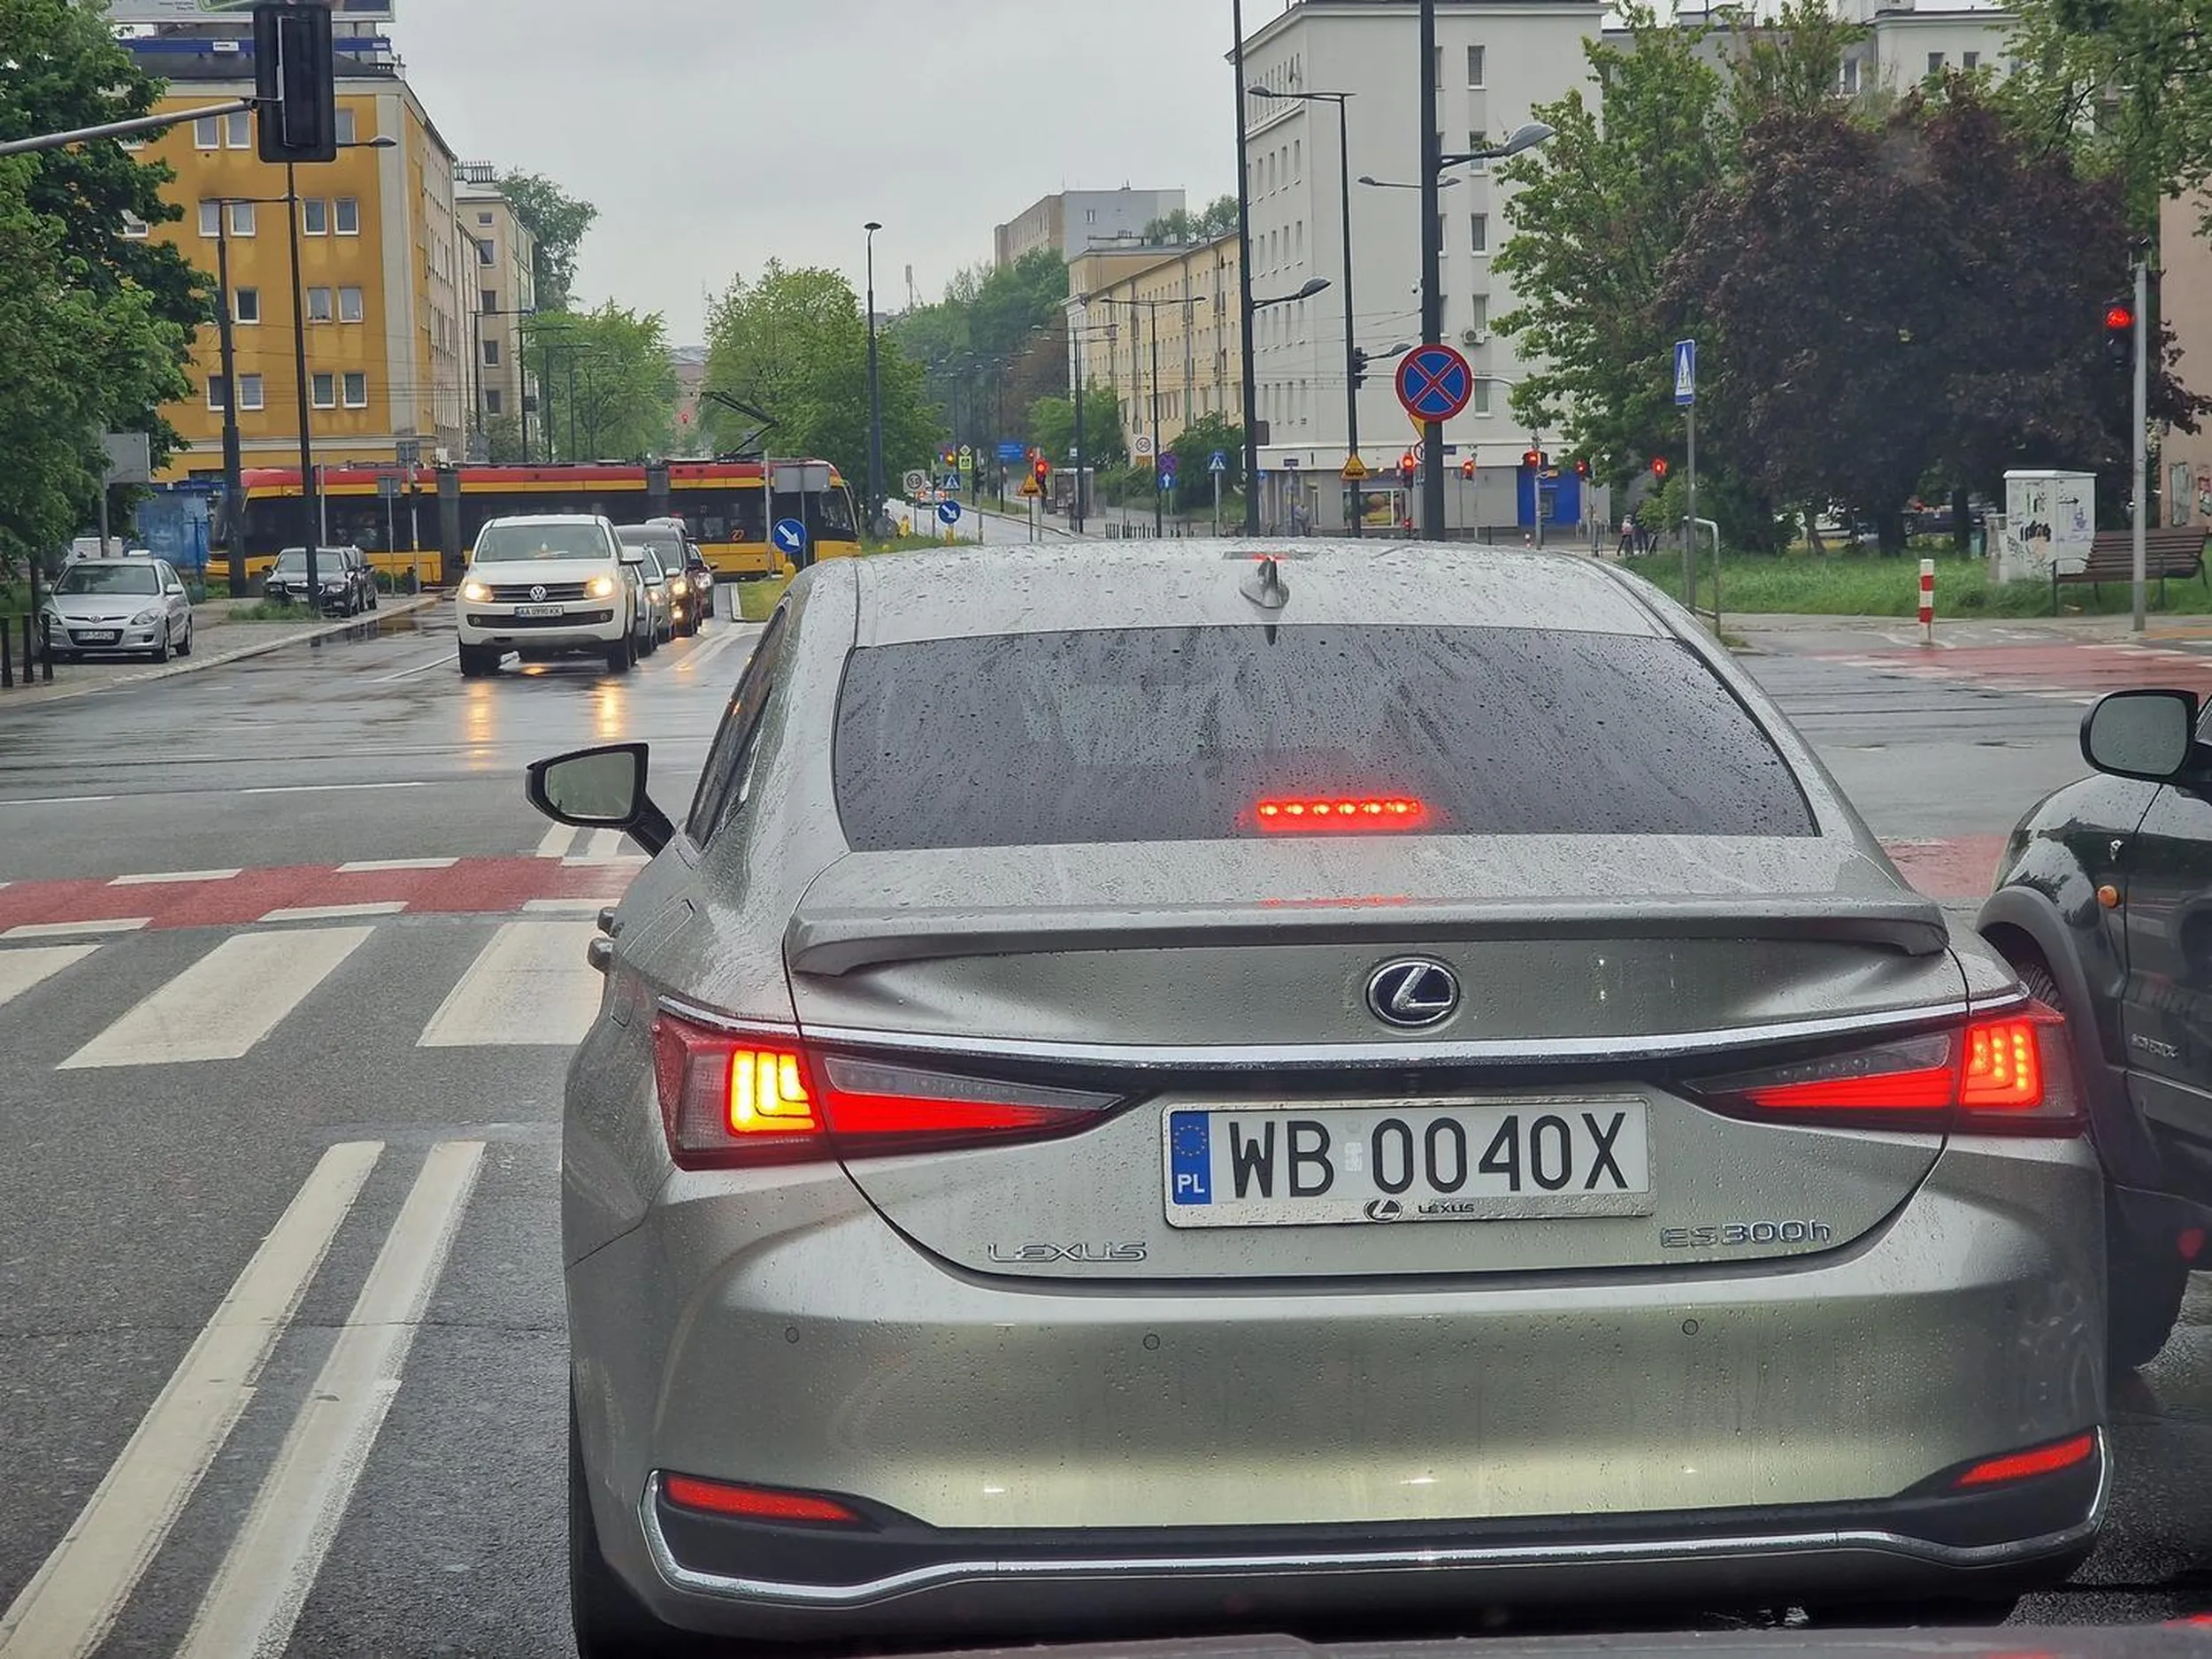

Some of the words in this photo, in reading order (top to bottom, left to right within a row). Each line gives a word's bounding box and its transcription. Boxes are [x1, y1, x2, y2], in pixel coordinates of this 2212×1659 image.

[1229, 1121, 1334, 1199] WB
[1371, 1112, 1629, 1194] 0040X
[1178, 1174, 1205, 1194] PL
[1418, 1203, 1475, 1215] LEXUS
[1661, 1219, 1831, 1248] ES300h
[988, 1241, 1148, 1263] LEXUS
